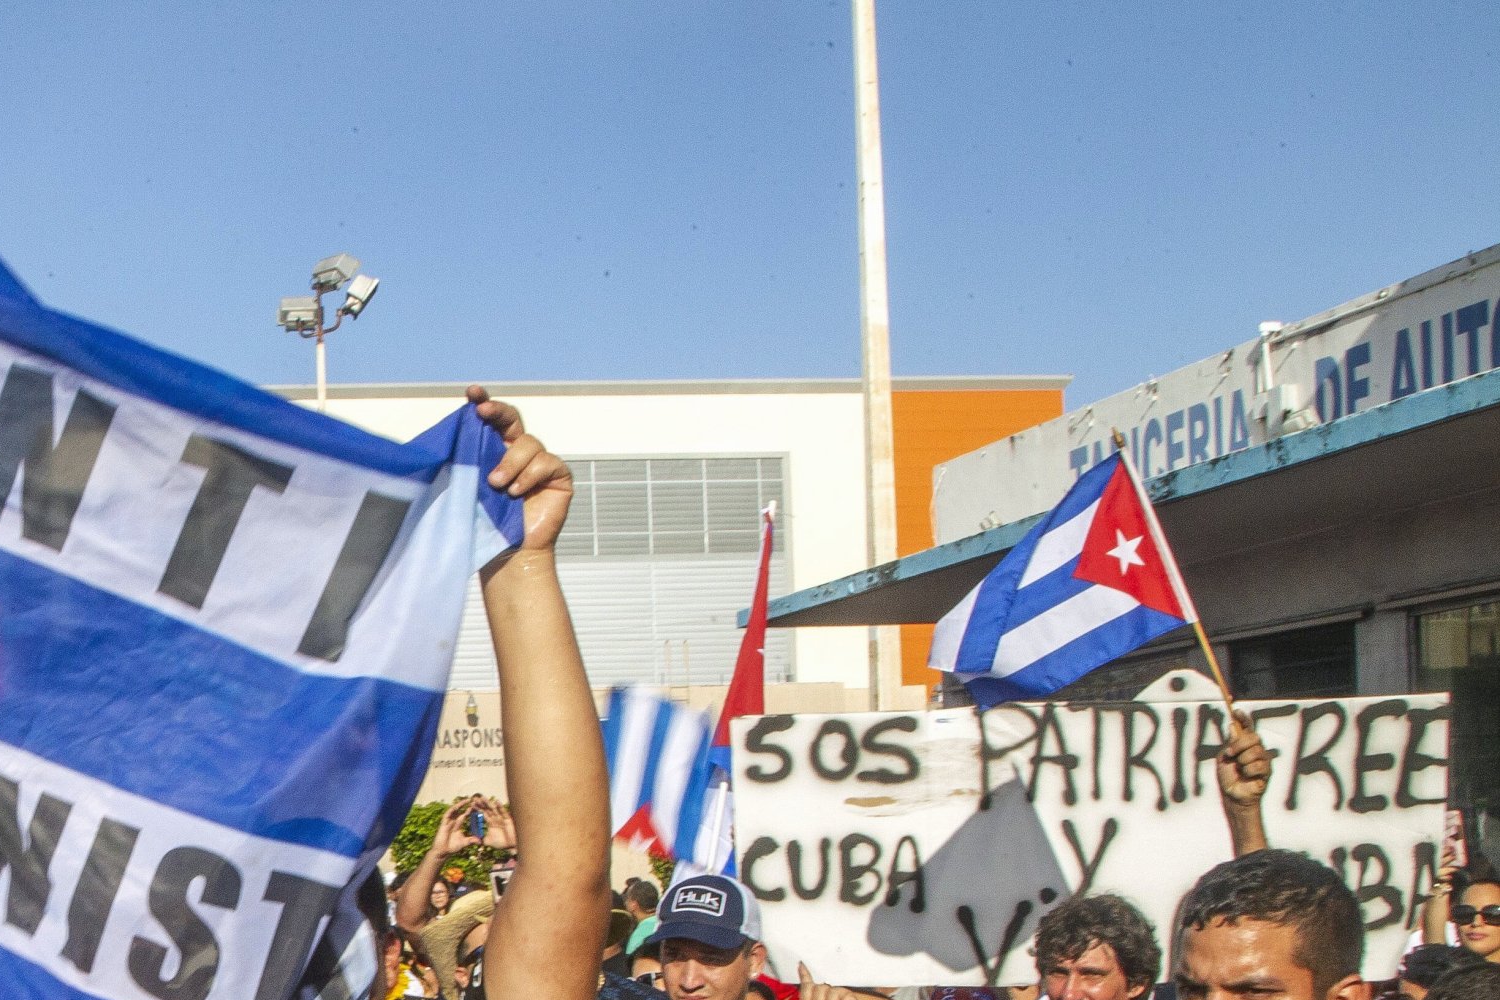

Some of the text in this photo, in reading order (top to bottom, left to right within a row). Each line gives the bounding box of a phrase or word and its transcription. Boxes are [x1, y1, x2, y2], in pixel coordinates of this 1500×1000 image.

[1315, 342, 1371, 423] DE
[430, 757, 466, 768] uneral
[745, 714, 920, 784] SOS
[973, 702, 1228, 811] PATRIA
[741, 833, 925, 913] CUBA
[1062, 816, 1118, 899] Y
[1331, 842, 1437, 930] BA
[677, 890, 720, 908] Huk
